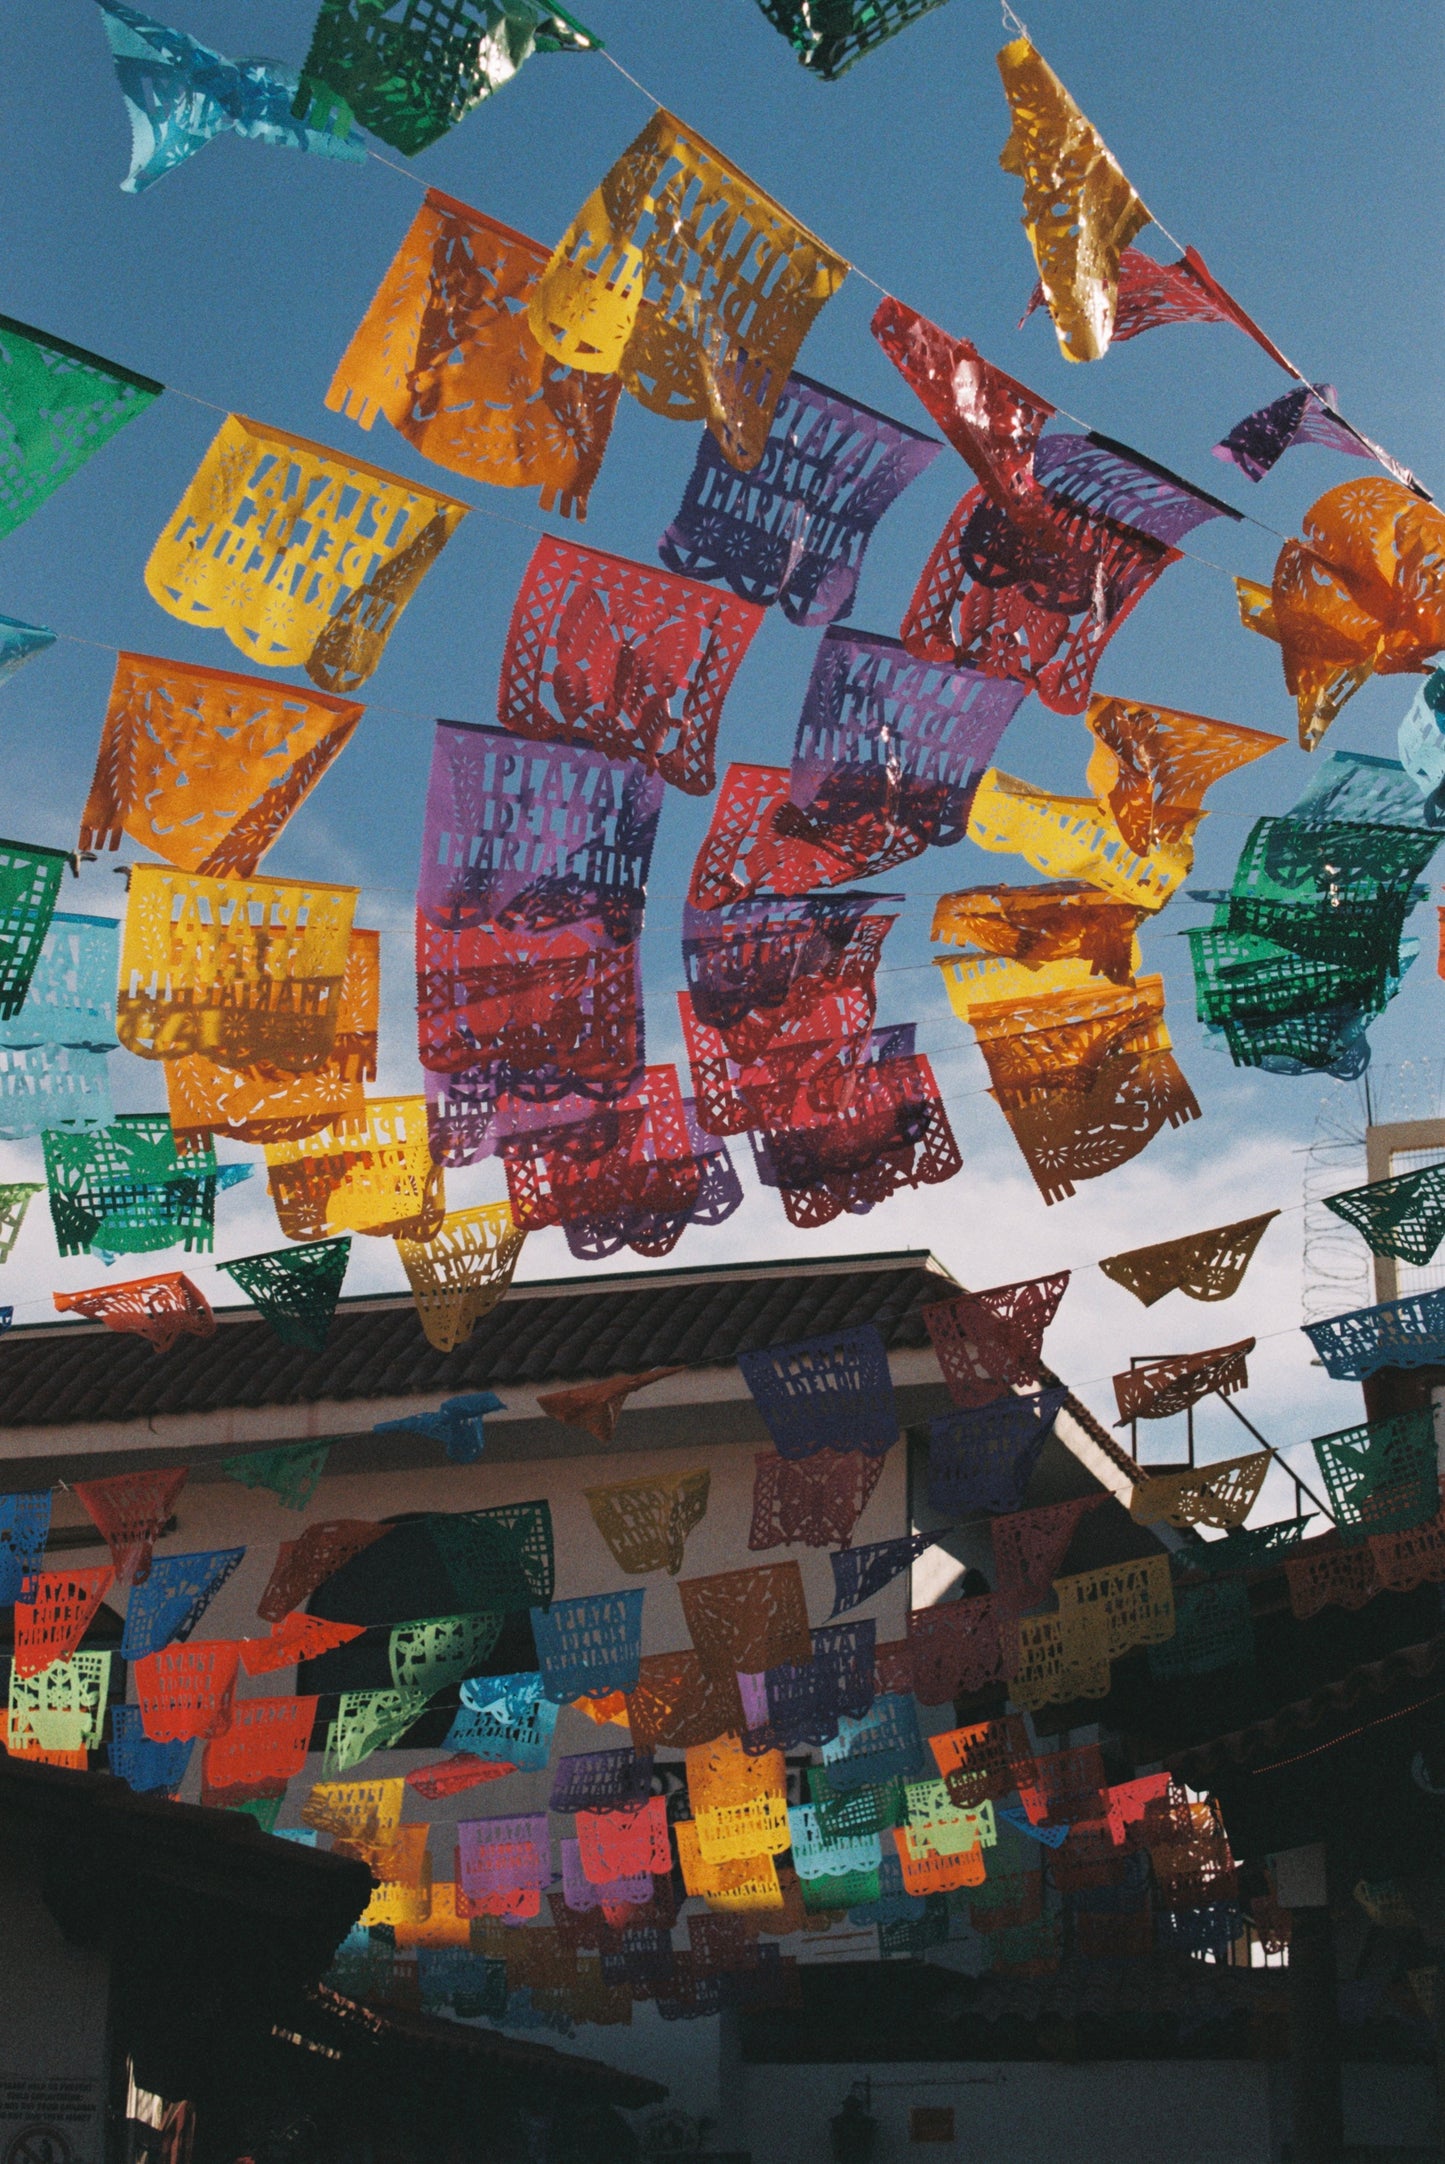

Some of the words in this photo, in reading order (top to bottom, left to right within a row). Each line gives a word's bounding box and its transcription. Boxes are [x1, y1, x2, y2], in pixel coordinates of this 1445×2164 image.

[482, 752, 625, 809] PLAZA
[437, 831, 643, 889] MARIACHIS
[1076, 1568, 1149, 1604] PLAZA
